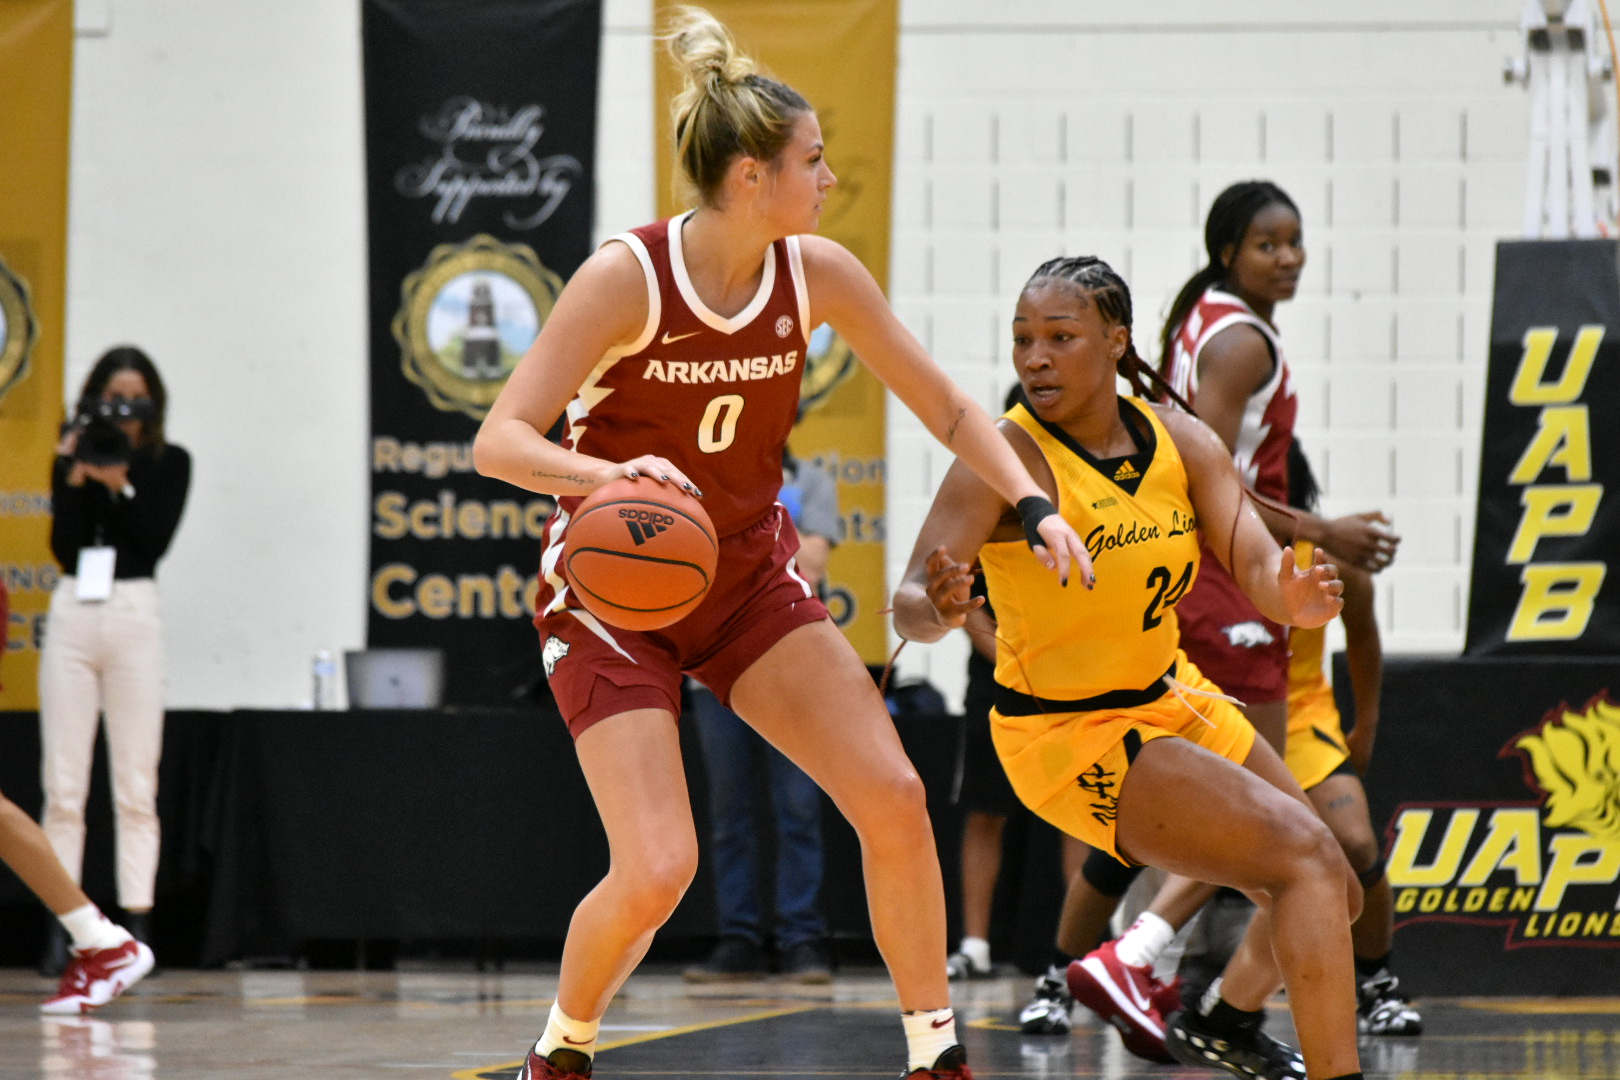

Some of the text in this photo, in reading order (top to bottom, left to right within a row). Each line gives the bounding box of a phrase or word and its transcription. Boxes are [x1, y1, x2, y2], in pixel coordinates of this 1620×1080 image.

[776, 316, 793, 338] SEC
[642, 350, 798, 385] ARKANSAS
[697, 394, 745, 454] 0
[1114, 471, 1140, 482] adidas
[1506, 325, 1607, 642] UAPB
[618, 508, 675, 526] adidas
[1085, 520, 1160, 563] Golden
[1385, 808, 1620, 912] UAP
[1394, 887, 1536, 913] GOLDEN
